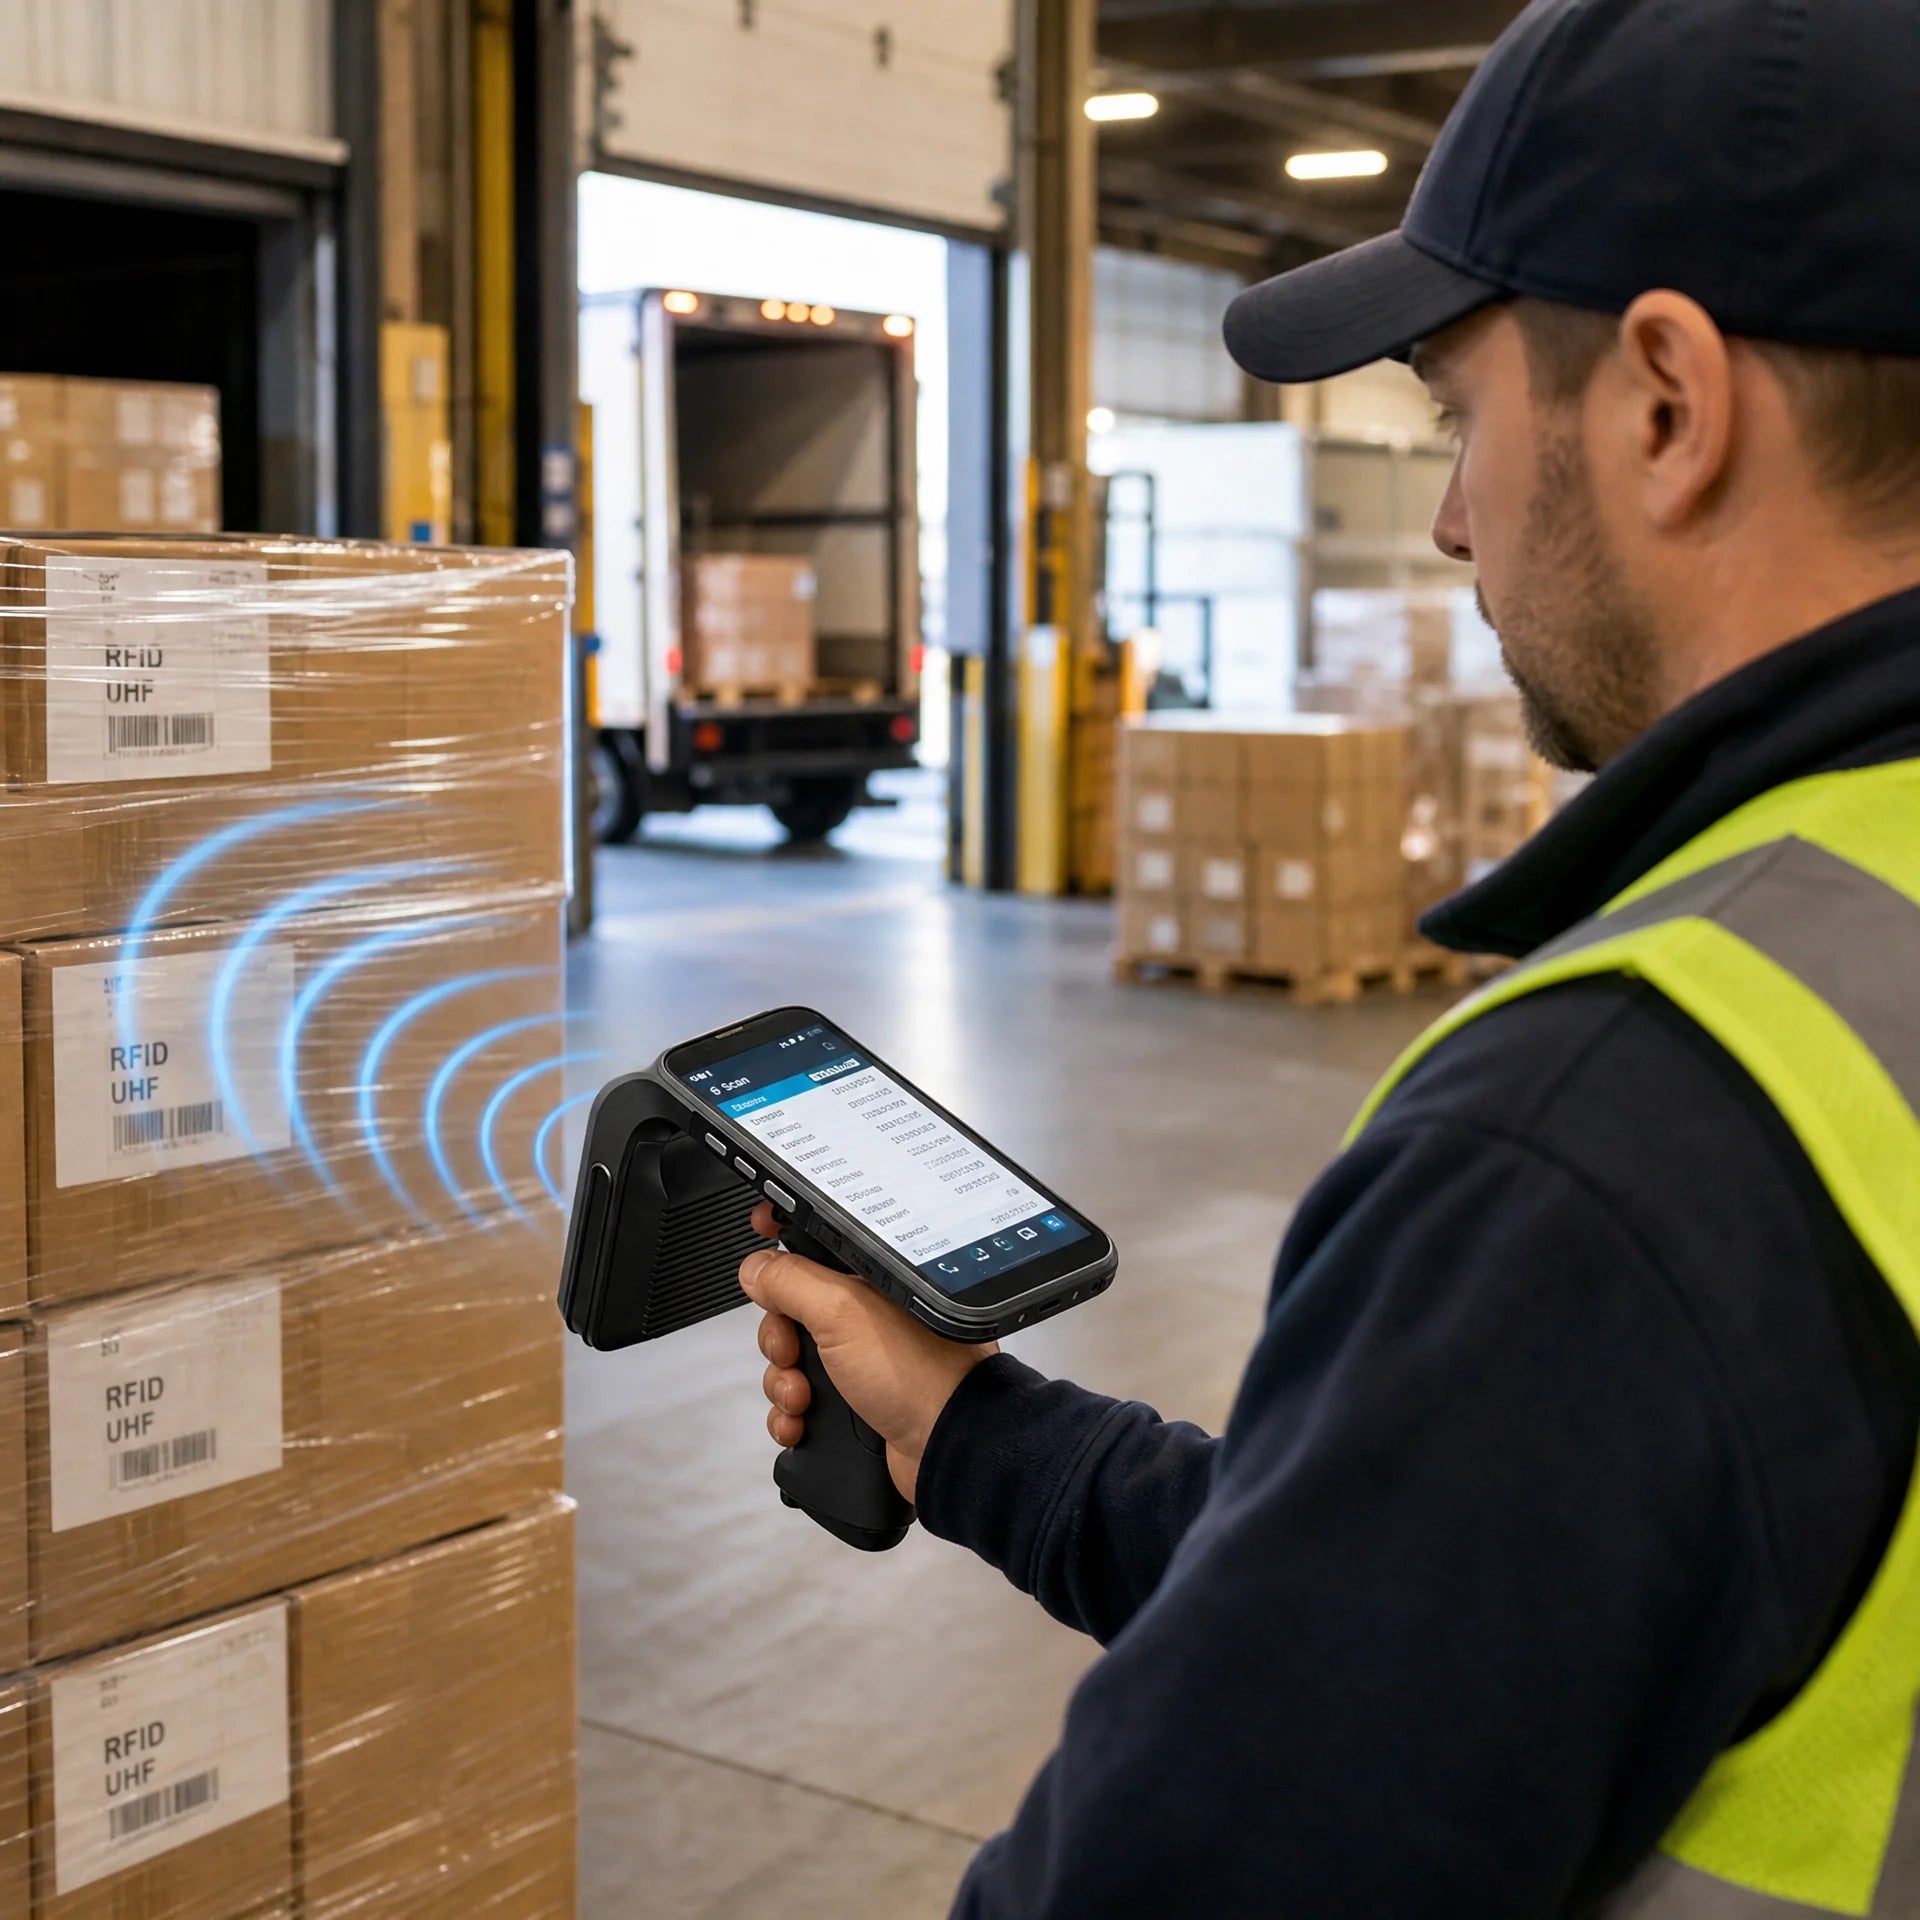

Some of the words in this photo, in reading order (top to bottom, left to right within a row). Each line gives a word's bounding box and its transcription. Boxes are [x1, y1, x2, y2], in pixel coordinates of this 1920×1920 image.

[105, 643, 163, 669] RFID
[106, 679, 155, 704] UHF
[110, 1041, 168, 1072] RFID
[111, 1077, 159, 1105] UHF
[721, 1076, 751, 1091] Scan
[106, 1376, 164, 1411] RFID
[106, 1412, 155, 1443] UHF
[104, 1721, 165, 1764] RFID
[105, 1758, 156, 1797] UHF
